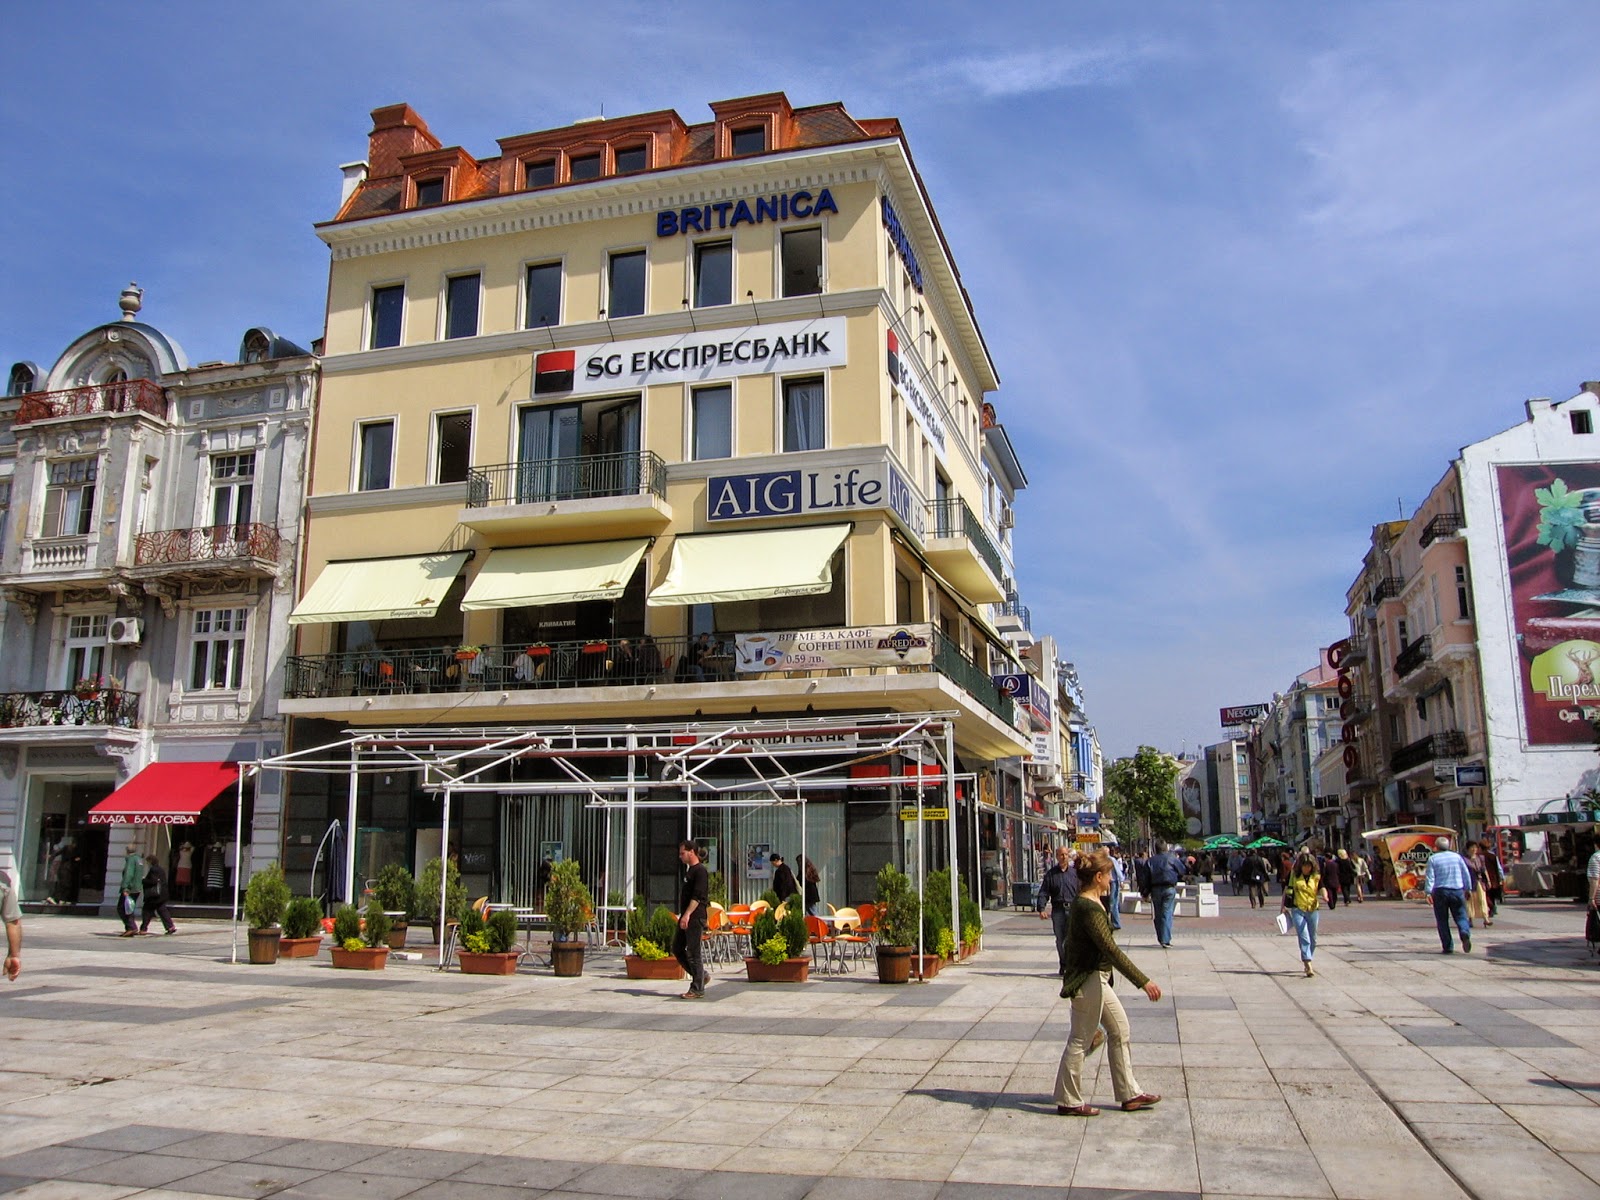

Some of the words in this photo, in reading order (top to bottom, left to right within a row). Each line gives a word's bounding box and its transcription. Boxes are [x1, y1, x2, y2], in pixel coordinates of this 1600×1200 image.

[657, 189, 839, 237] BRITANICA
[586, 353, 623, 378] SG
[631, 331, 831, 373] ЕКСПРЕСБАНК
[711, 472, 796, 518] AIG
[808, 469, 883, 509] Life
[890, 472, 910, 526] AIG
[538, 620, 576, 629] КЛИМАТИК
[778, 631, 817, 642] ВРЕМЕ
[819, 630, 835, 641] ЗА
[838, 628, 873, 640] КАФЕ
[797, 641, 841, 652] COFFEE
[844, 639, 874, 650] TIME
[880, 638, 925, 648] AFREDDO
[786, 654, 806, 664] 0.59
[1549, 675, 1600, 705] Перел
[91, 814, 128, 824] БЛАГА
[134, 814, 195, 824] БЛАГОЕВА
[1400, 851, 1429, 860] AFRED
